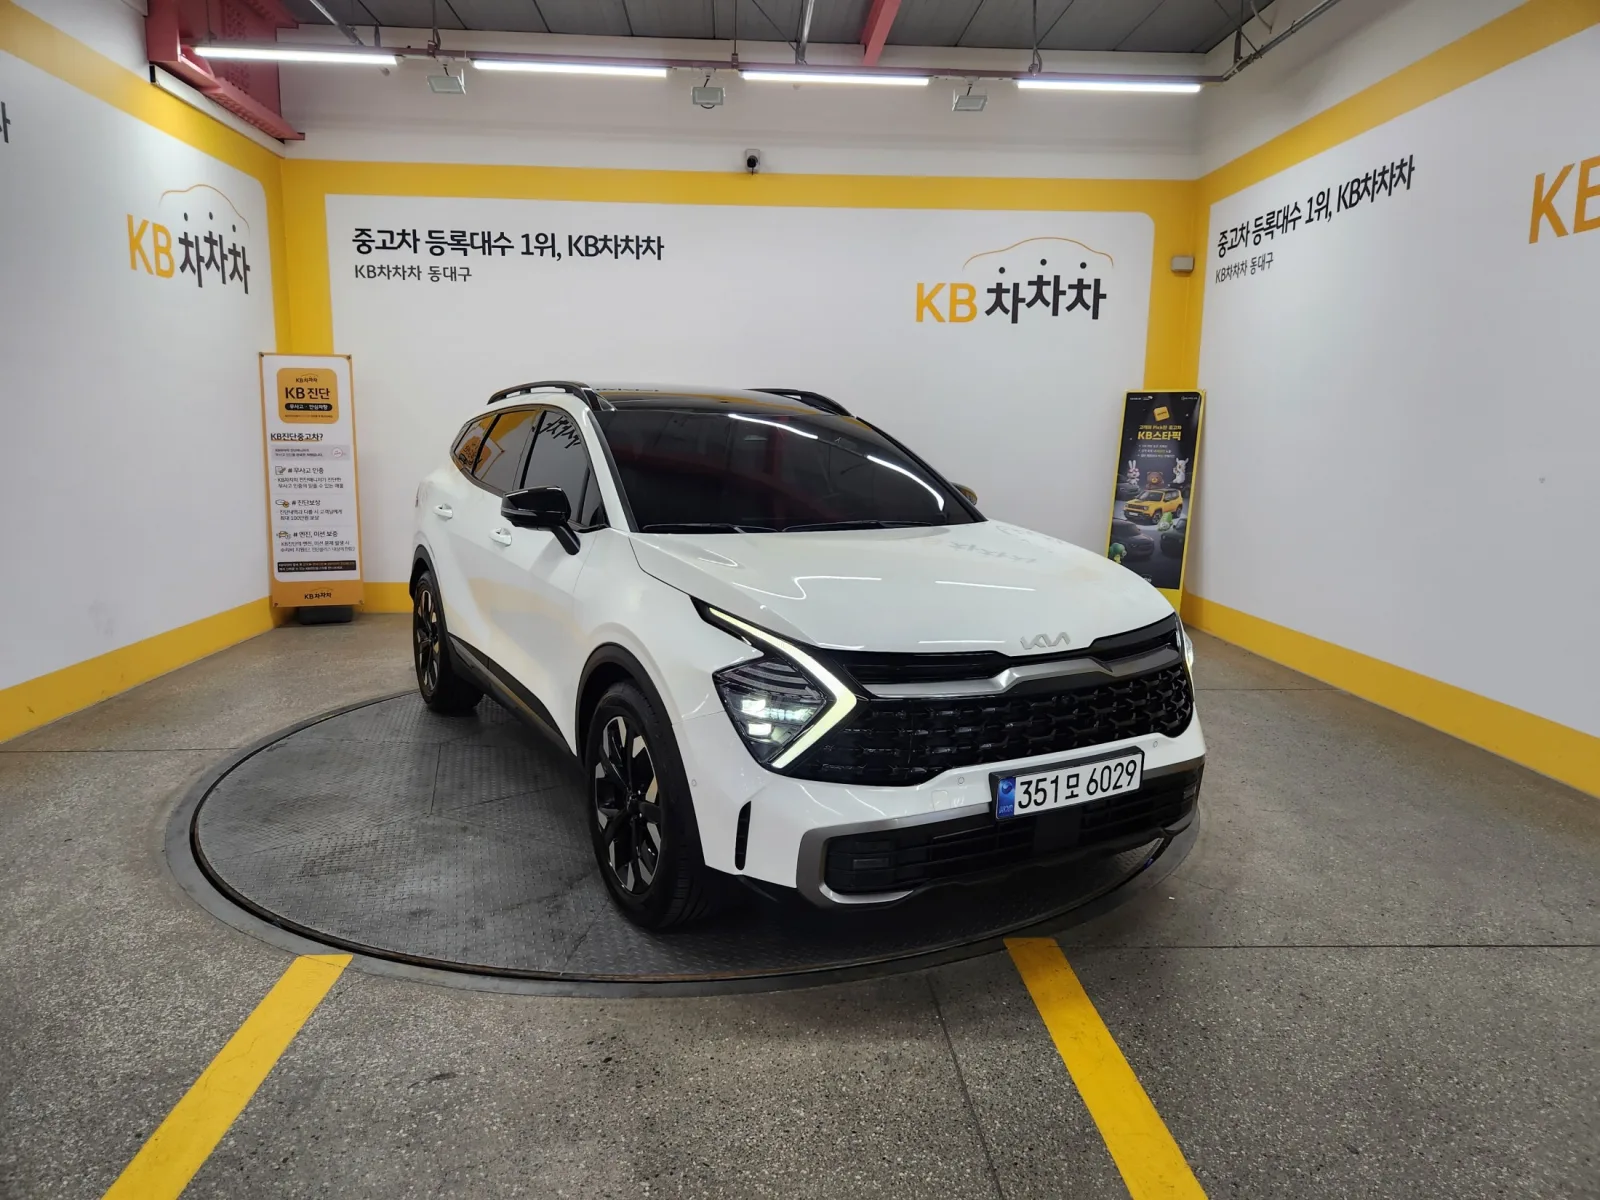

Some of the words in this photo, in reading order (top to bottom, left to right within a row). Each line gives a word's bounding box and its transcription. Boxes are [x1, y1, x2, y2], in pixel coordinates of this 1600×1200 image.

[1217, 220, 1250, 258] 중고차
[1252, 201, 1302, 246] 등록대수
[1305, 187, 1332, 223] 1위,
[1337, 154, 1415, 213] KB차차차
[127, 213, 175, 279] KB
[178, 211, 250, 294] 차차차
[352, 228, 421, 254] 중고차
[425, 230, 514, 257] 등록대수
[521, 232, 562, 261] 1위,
[568, 234, 664, 261] KB차차차
[354, 264, 422, 281] KB차차차
[427, 265, 472, 282] 동대구
[1215, 259, 1247, 284] KB차차차
[1250, 251, 1274, 275] 동대구
[915, 282, 977, 323] KB
[985, 258, 1107, 324] 차차차
[285, 387, 305, 399] KB
[307, 387, 330, 400] 진단
[270, 432, 323, 441] KB진단중고차?
[1137, 431, 1181, 441] KB스타픽
[315, 591, 332, 599] 차차차
